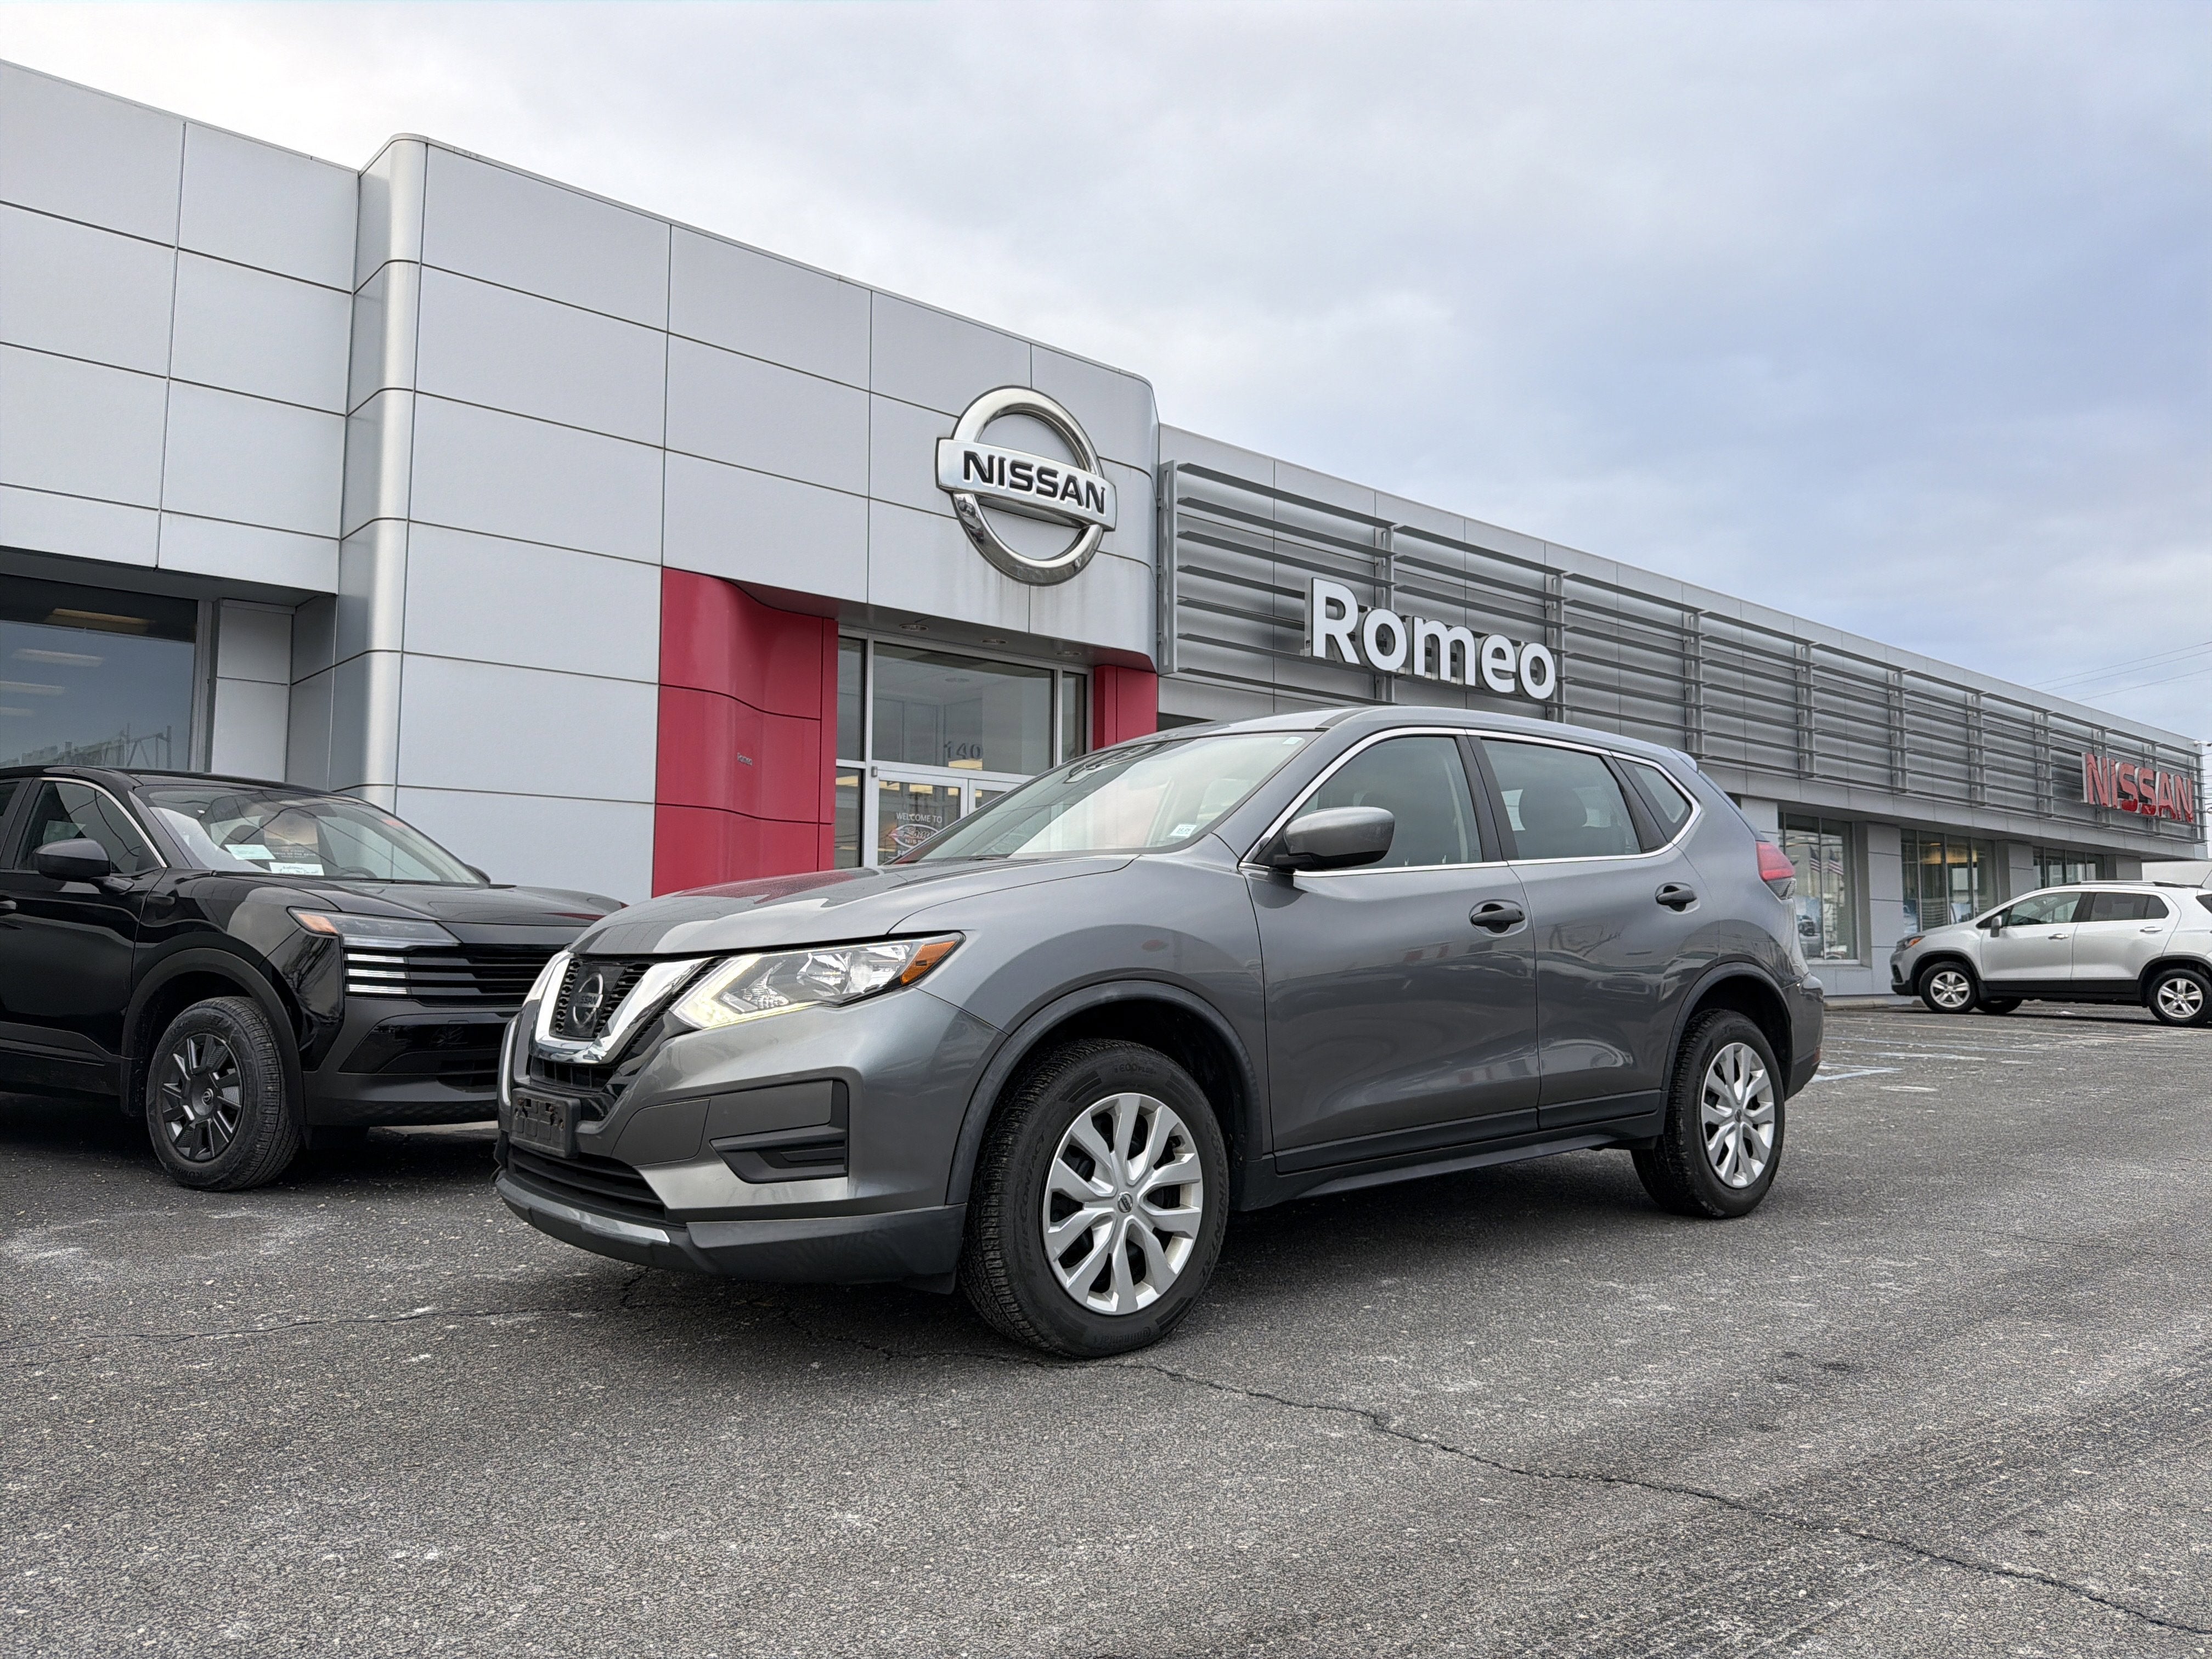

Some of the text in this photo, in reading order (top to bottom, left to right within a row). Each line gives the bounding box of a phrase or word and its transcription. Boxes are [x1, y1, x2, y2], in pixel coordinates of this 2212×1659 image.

[963, 450, 1105, 515] NISSAN
[1310, 577, 1556, 700] Romeo
[896, 812, 932, 822] WELCOME
[2084, 752, 2193, 822] NISSAN
